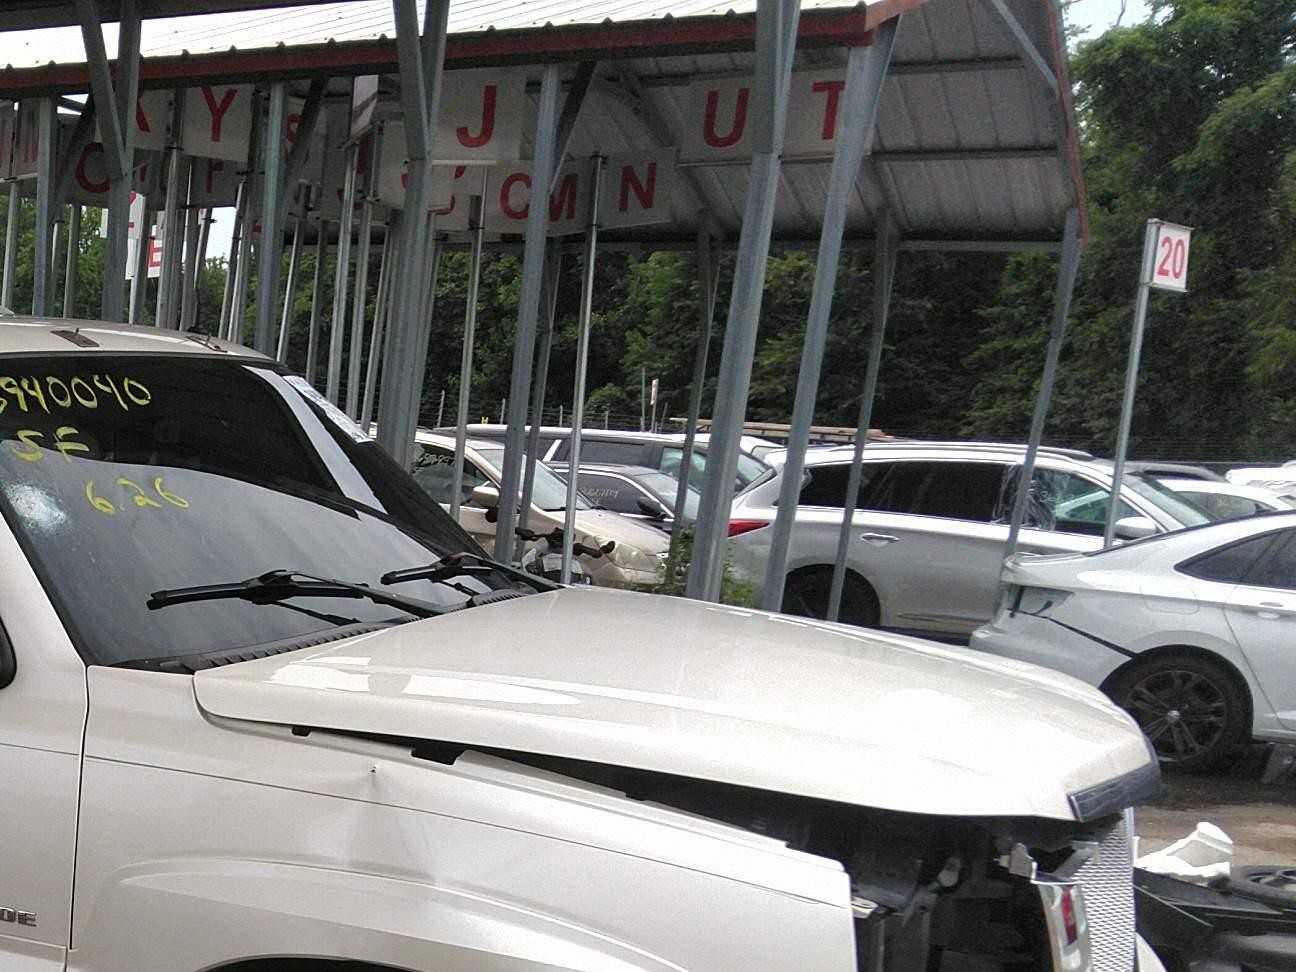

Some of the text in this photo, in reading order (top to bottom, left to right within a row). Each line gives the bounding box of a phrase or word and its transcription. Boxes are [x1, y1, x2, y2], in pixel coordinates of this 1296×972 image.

[201, 83, 239, 142] Y
[456, 85, 497, 148] J
[703, 88, 750, 148] U
[812, 80, 846, 141] T
[618, 162, 657, 212] N
[1157, 236, 1185, 280] 20
